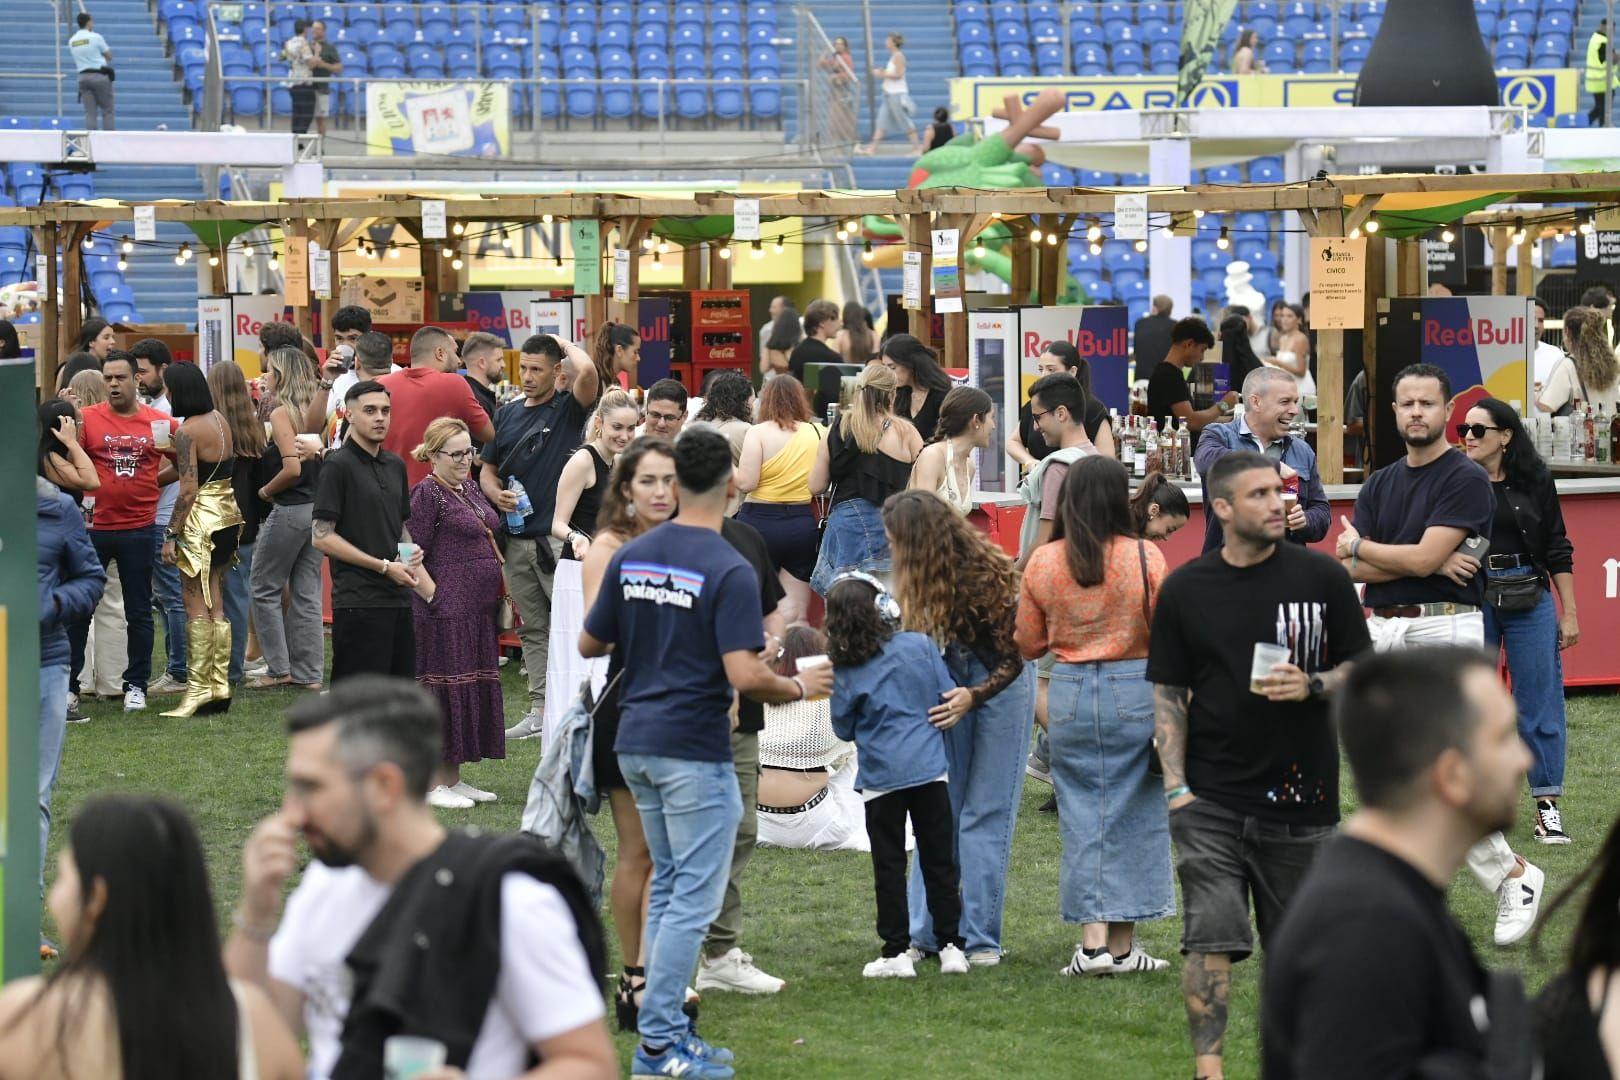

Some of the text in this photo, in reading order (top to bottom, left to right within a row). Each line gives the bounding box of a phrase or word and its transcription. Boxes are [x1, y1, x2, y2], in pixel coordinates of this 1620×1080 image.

[640, 316, 668, 342] ull
[1078, 328, 1126, 357] Bull
[1424, 317, 1524, 346] Red Bull
[623, 584, 693, 609] patagonia
